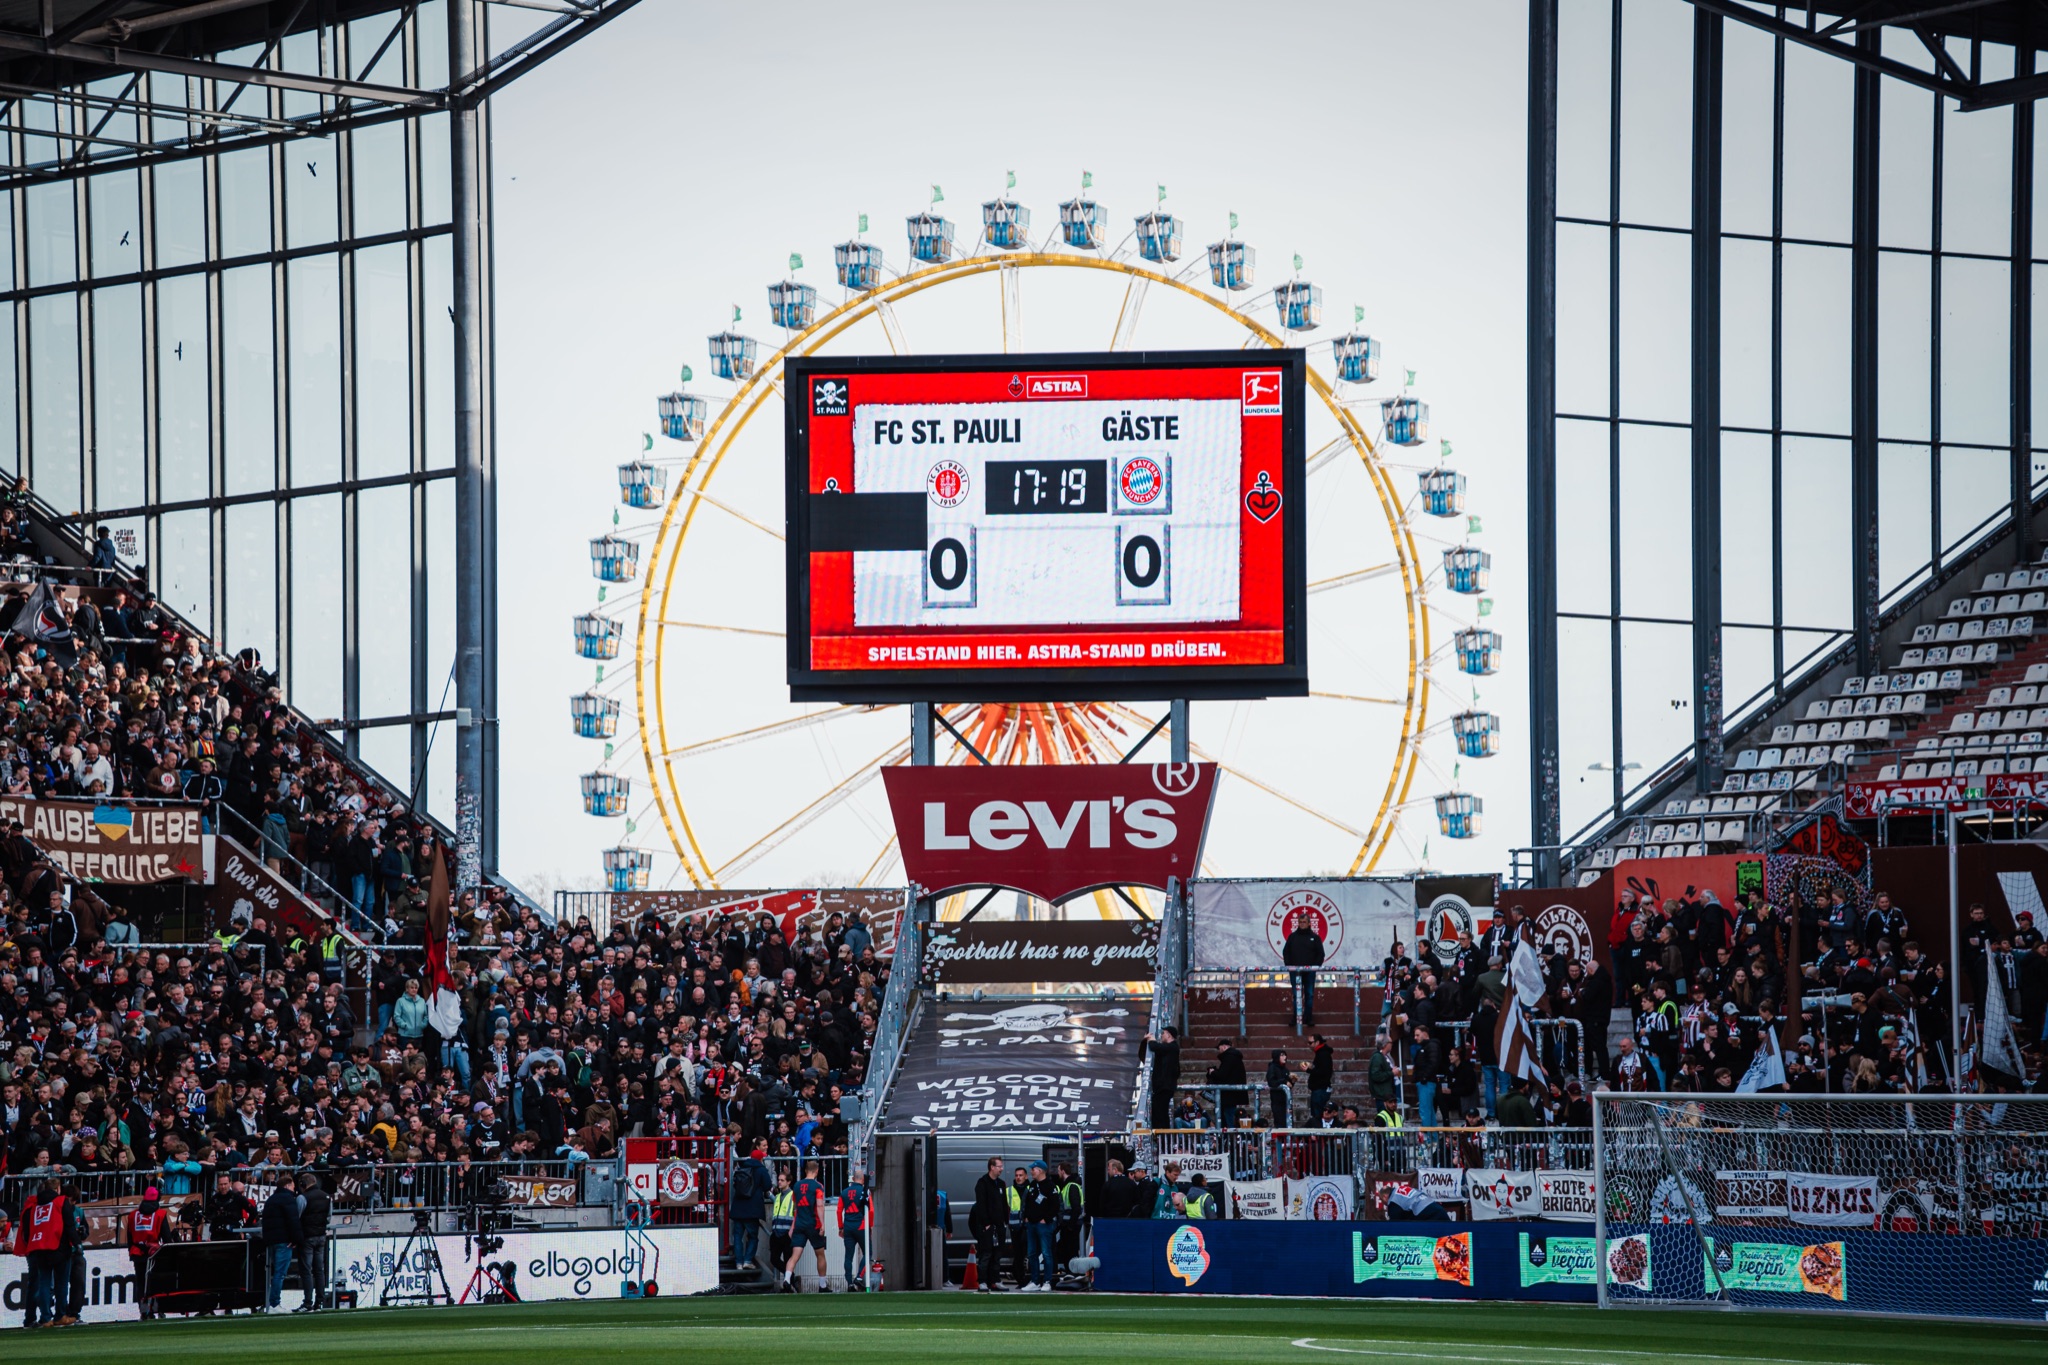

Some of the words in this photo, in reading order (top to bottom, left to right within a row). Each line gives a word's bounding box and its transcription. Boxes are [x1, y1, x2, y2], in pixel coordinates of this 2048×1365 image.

[1031, 380, 1083, 393] ASTRA
[874, 420, 904, 445] FC
[911, 419, 945, 444] ST.
[953, 418, 1022, 444] PAULI
[1102, 410, 1180, 442] GÄSTE
[928, 472, 936, 483] FC
[948, 462, 968, 484] PAULI
[1123, 466, 1132, 479] FC
[1131, 458, 1160, 478] BAYERN
[1013, 468, 1087, 506] 17:19
[939, 498, 958, 506] 1910
[929, 537, 968, 591] 0
[1123, 534, 1162, 588] 0
[868, 646, 971, 662] SPIELSTAND
[977, 645, 1022, 660] HIER.
[1027, 643, 1145, 660] ASTRA-STAND
[1151, 640, 1227, 658] DRÜBEN.
[1871, 784, 1964, 813] ASTRA
[129, 810, 200, 845] LIEBE
[44, 849, 175, 882] OFFNUNG
[254, 883, 280, 909] die
[1270, 911, 1282, 927] FC
[1281, 894, 1303, 911] ST.
[1305, 893, 1340, 927] PAULI
[924, 938, 1018, 963] Football
[1020, 940, 1059, 960] has
[1062, 946, 1089, 959] no
[939, 1038, 988, 1047] ST.
[998, 1034, 1116, 1046] PAULI
[916, 1074, 1115, 1091] WELCOME
[941, 1086, 997, 1099] TO
[1005, 1085, 1082, 1099] THE
[928, 1099, 1025, 1112] HELL
[1033, 1099, 1091, 1111] OF
[910, 1116, 962, 1129] ST.
[634, 1174, 650, 1189] C1
[1472, 1181, 1490, 1202] ÖN
[1515, 1188, 1532, 1202] SP
[1553, 1180, 1586, 1196] ROTE
[1242, 1193, 1276, 1201] ASOZIALES
[1727, 1179, 1778, 1206] BRSP
[1241, 1207, 1278, 1217] NETZWERK
[1170, 1253, 1198, 1265] Lifestyle
[1177, 1243, 1202, 1255] Healthy
[1382, 1252, 1423, 1271] vegan
[1551, 1255, 1595, 1275] vegan
[1738, 1261, 1786, 1281] vegan
[353, 1266, 374, 1281] MOIN
[529, 1249, 634, 1295] elbgold
